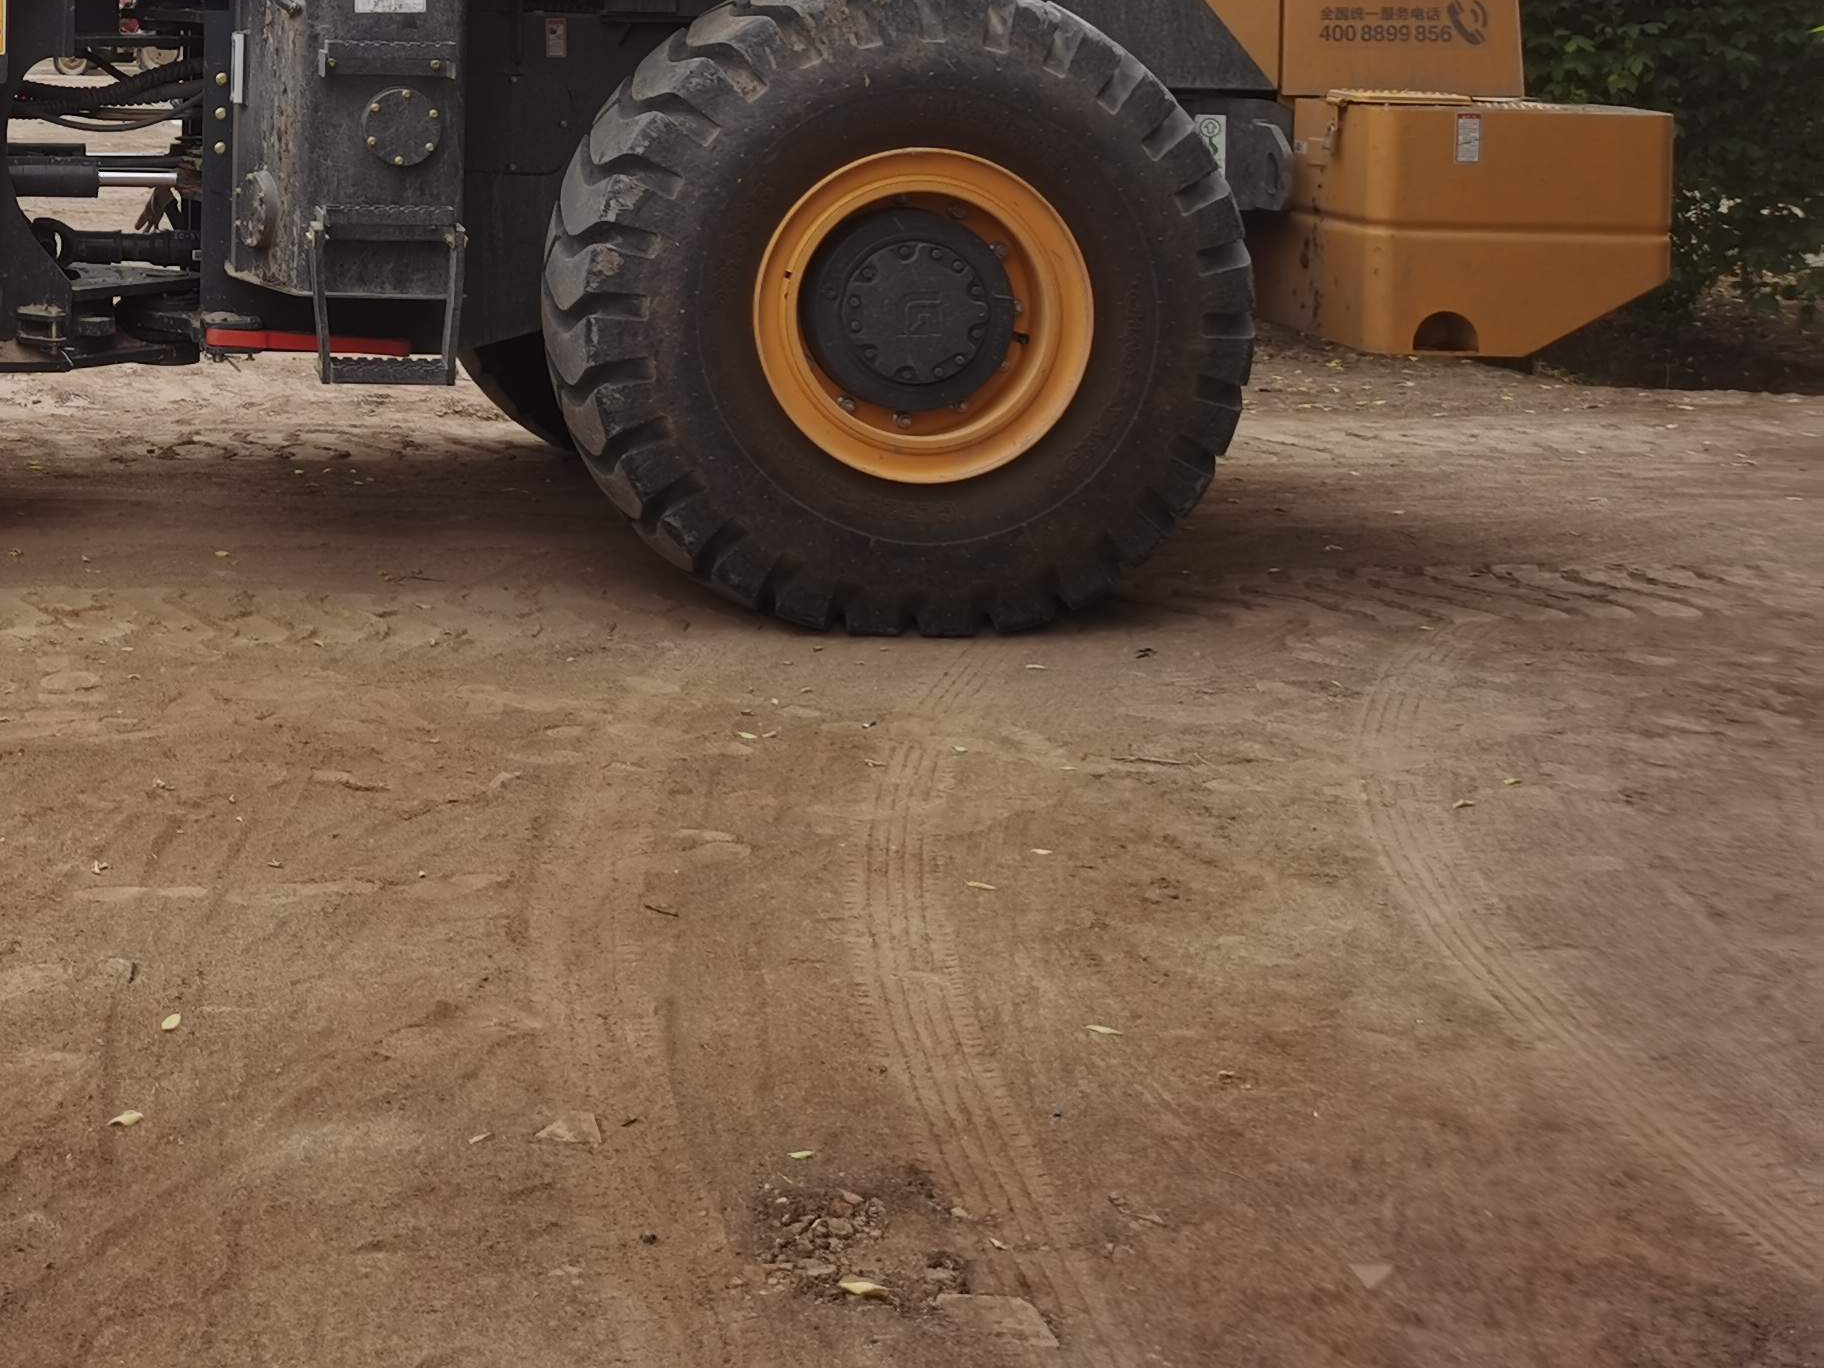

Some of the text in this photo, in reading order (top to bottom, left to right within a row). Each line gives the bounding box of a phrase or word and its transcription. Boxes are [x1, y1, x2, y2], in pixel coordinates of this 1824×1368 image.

[1320, 7, 1441, 21] 全国统一服务电话
[1319, 24, 1453, 43] 400 8899 856
